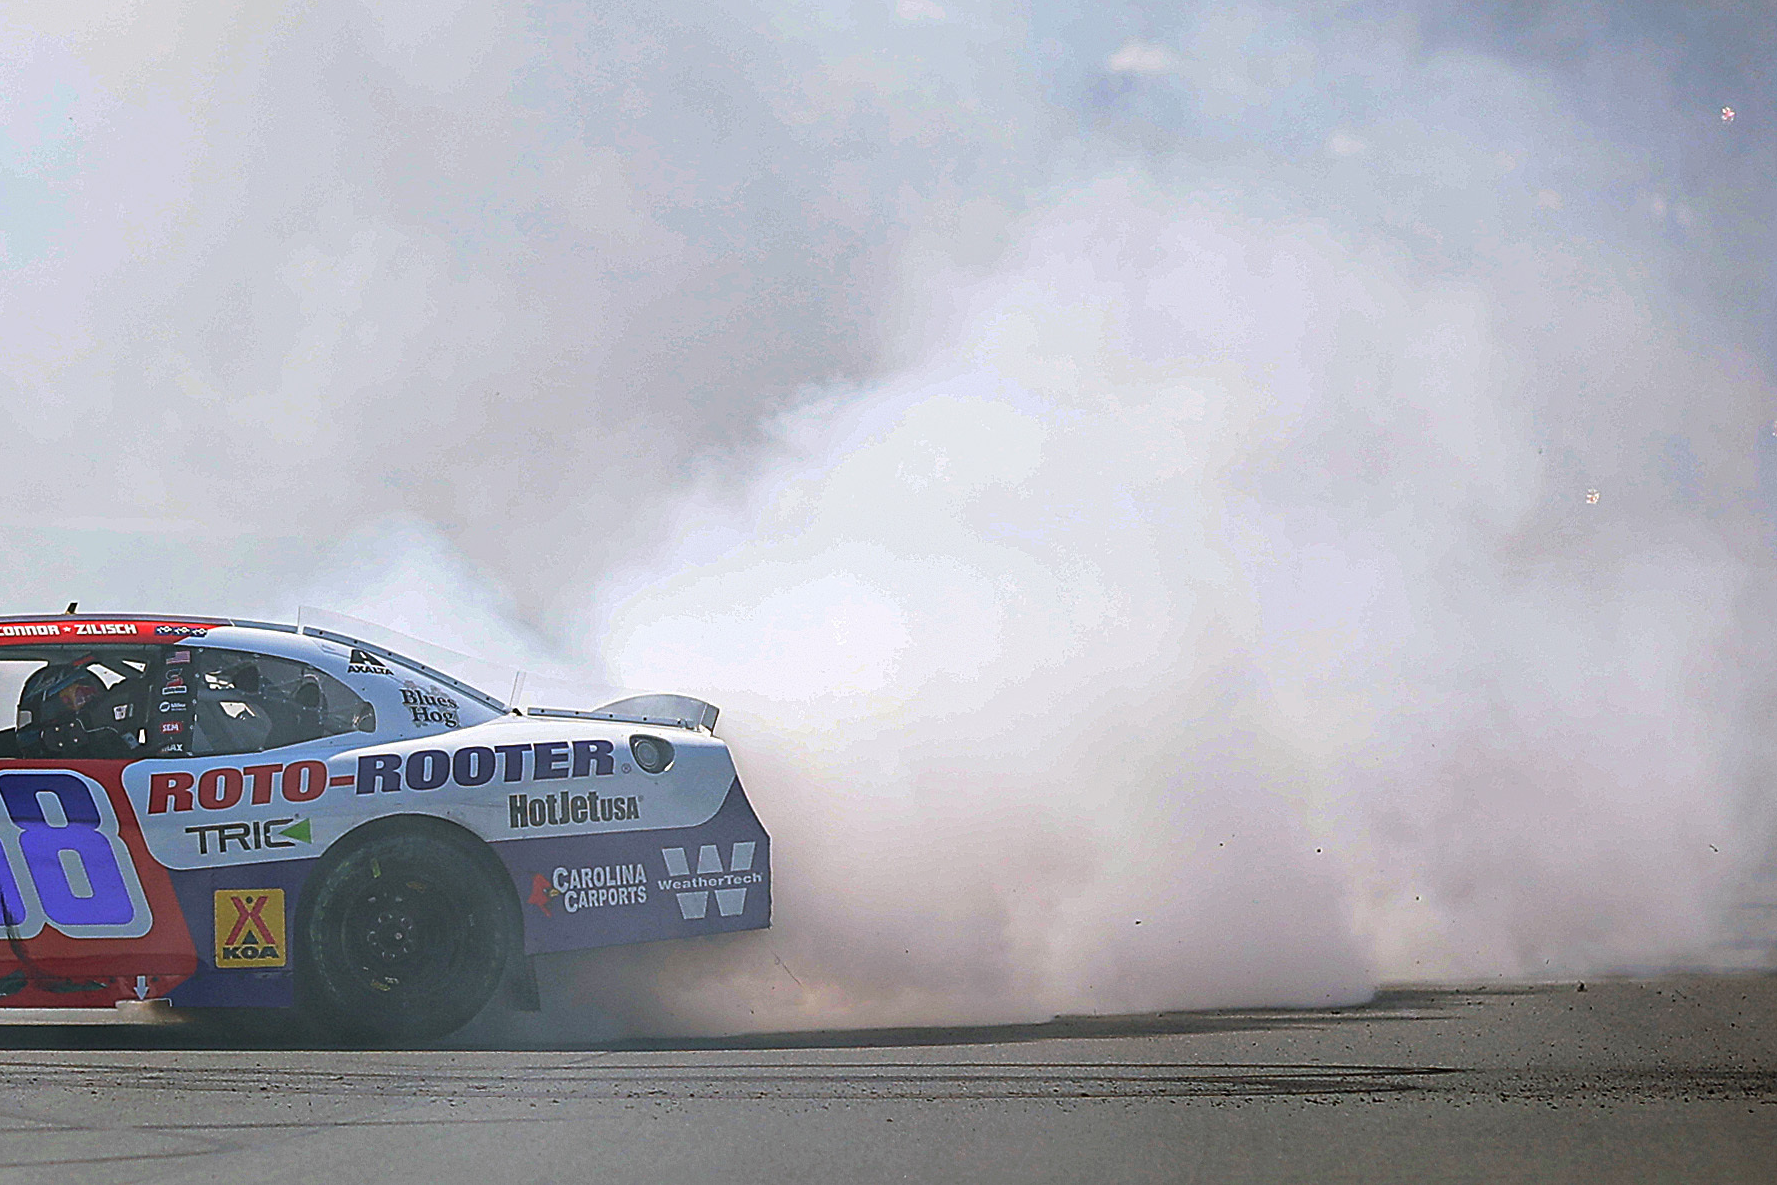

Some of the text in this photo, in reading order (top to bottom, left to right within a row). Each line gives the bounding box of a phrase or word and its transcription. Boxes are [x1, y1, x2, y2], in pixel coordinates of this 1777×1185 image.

[74, 624, 138, 635] ZILISCH
[347, 665, 394, 675] AXALTA
[399, 688, 459, 709] Blues
[410, 706, 457, 728] Hog
[148, 739, 616, 814] ROTO-ROOTER
[553, 863, 647, 894] CAROLINA
[658, 873, 762, 890] WeatherTech
[564, 885, 647, 913] CARPORTS
[223, 946, 280, 960] KOA
